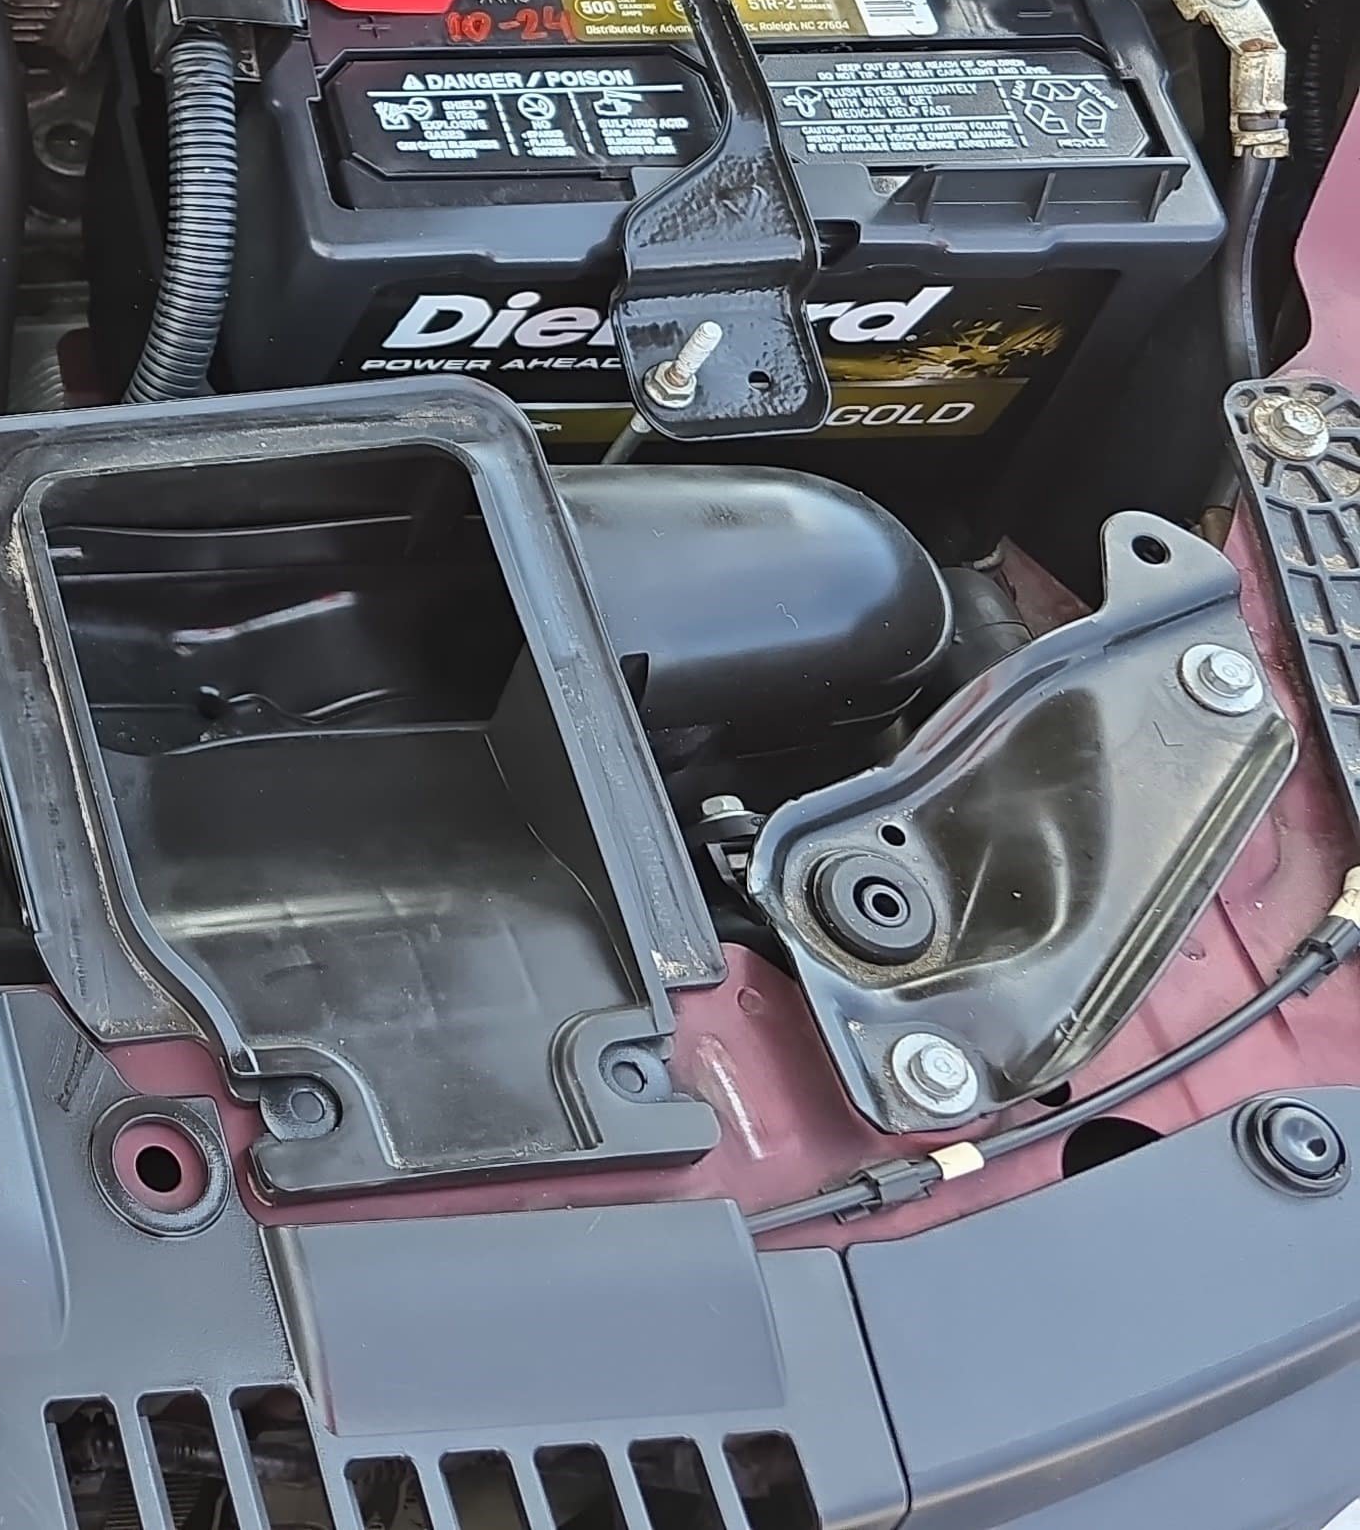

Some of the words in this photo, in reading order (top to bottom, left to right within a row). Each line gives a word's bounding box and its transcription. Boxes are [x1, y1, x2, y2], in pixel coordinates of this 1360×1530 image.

[580, 0, 617, 15] 500
[585, 24, 641, 35] Distributed
[642, 24, 658, 37] by:
[759, 21, 800, 33] Raleigh,
[801, 22, 816, 31] NC
[835, 64, 862, 72] KEEP
[863, 62, 886, 71] OUT
[886, 62, 901, 71] OF
[902, 61, 923, 70] THE
[924, 60, 959, 70] REACH
[960, 60, 974, 68] OF
[976, 59, 1027, 68] CHILDREN
[425, 72, 523, 90] DANGER
[542, 70, 635, 88] POISON
[817, 72, 834, 81] DO
[835, 71, 858, 80] NOT
[880, 70, 908, 79] KEEP
[908, 70, 936, 79] VENT
[937, 68, 967, 77] CAPS
[968, 67, 995, 75] TIGHT
[997, 67, 1022, 75] AND
[1023, 66, 1052, 74] LEVEL
[822, 86, 862, 99] FLUSH
[864, 85, 896, 97] EYES
[898, 83, 979, 96] IMMEDIATELY
[826, 97, 859, 109] WITH
[909, 95, 934, 106] GET
[832, 108, 886, 119] MEDICAL
[888, 106, 921, 118] HELP
[922, 105, 953, 117] FAST
[420, 119, 489, 131] EXPLOSIVE
[531, 120, 551, 130] NO
[598, 118, 658, 130] SULFURIC
[659, 118, 690, 129] ACID
[846, 125, 867, 134] FOR
[868, 124, 893, 134] SAFE
[894, 124, 920, 133] JUMP
[920, 121, 969, 132] STARTING
[970, 121, 1010, 130] FOLLOW
[360, 358, 492, 371] POWER
[823, 401, 976, 428] GOLD
